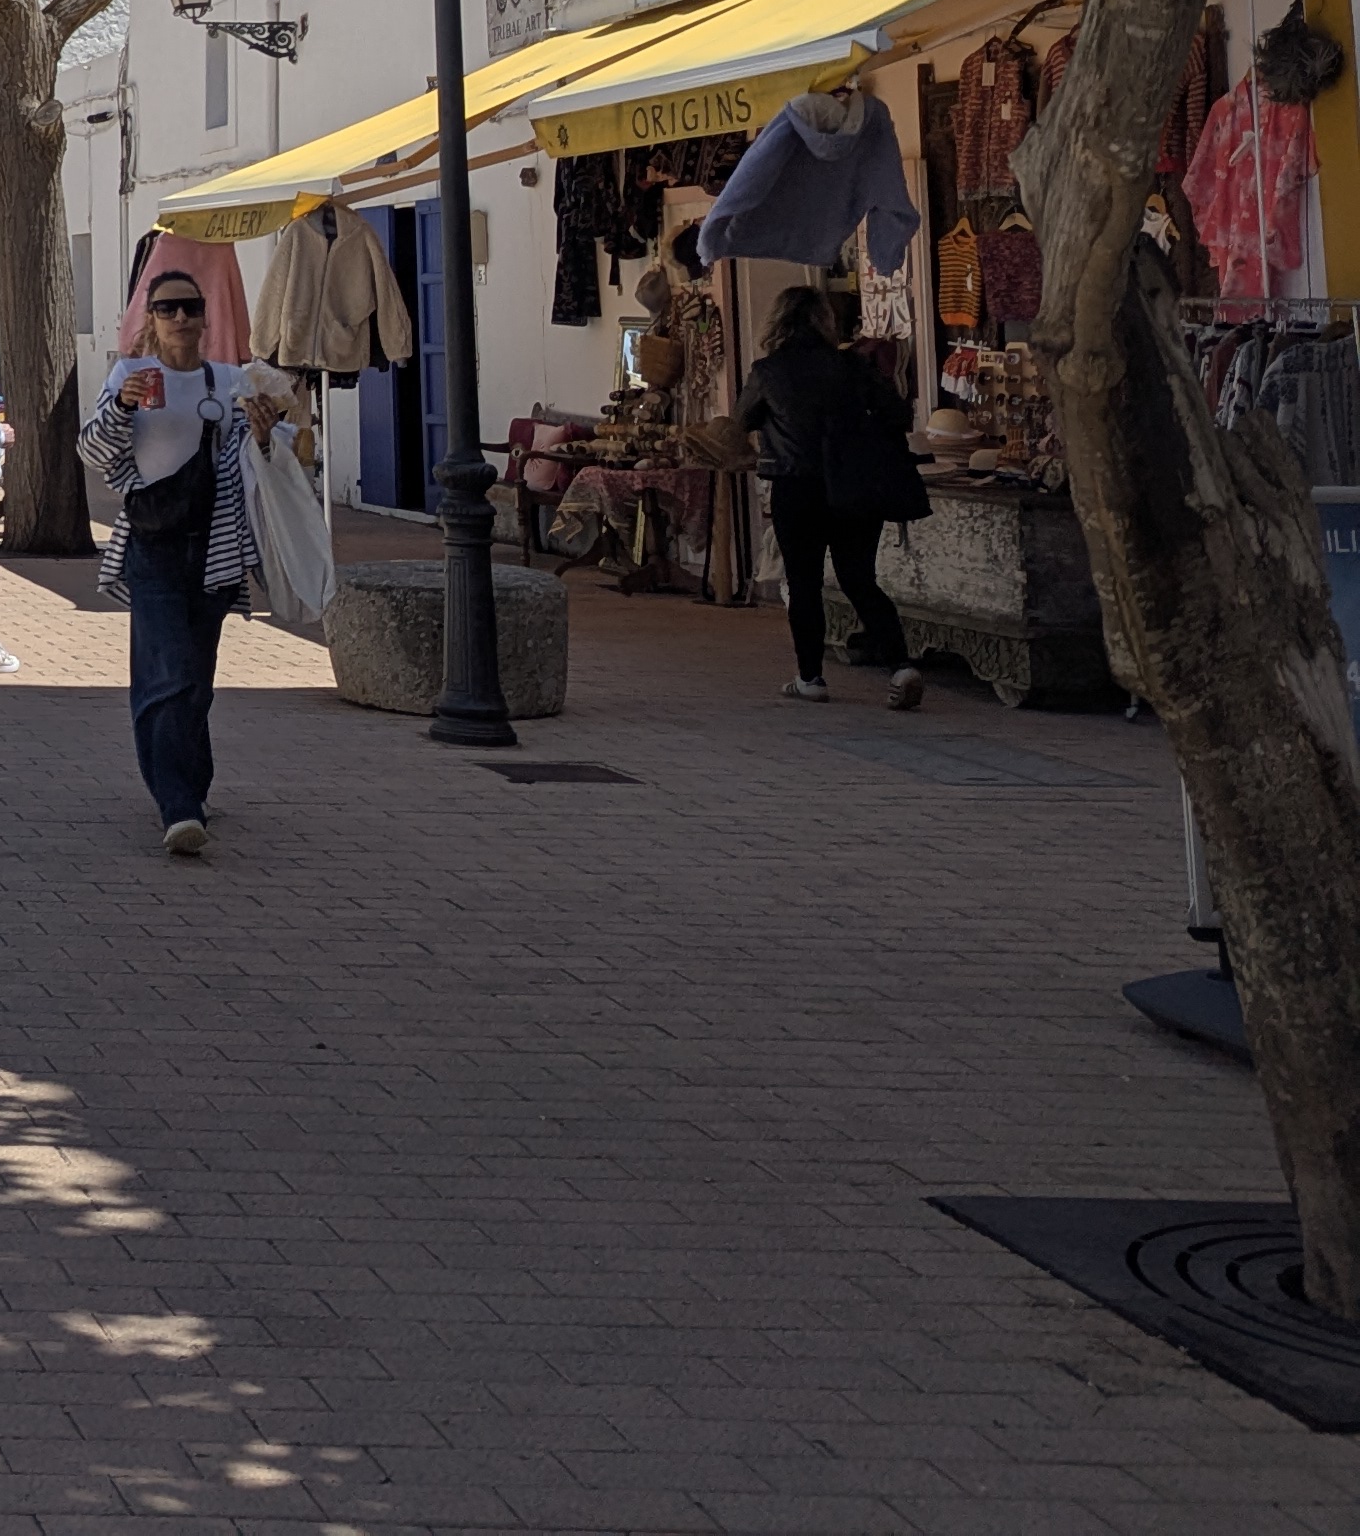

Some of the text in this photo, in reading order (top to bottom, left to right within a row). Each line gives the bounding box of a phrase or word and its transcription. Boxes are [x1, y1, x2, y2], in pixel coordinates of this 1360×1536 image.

[491, 11, 542, 43] TRIBAL ART
[632, 87, 752, 139] ORIGINS
[204, 209, 268, 238] GALLERY
